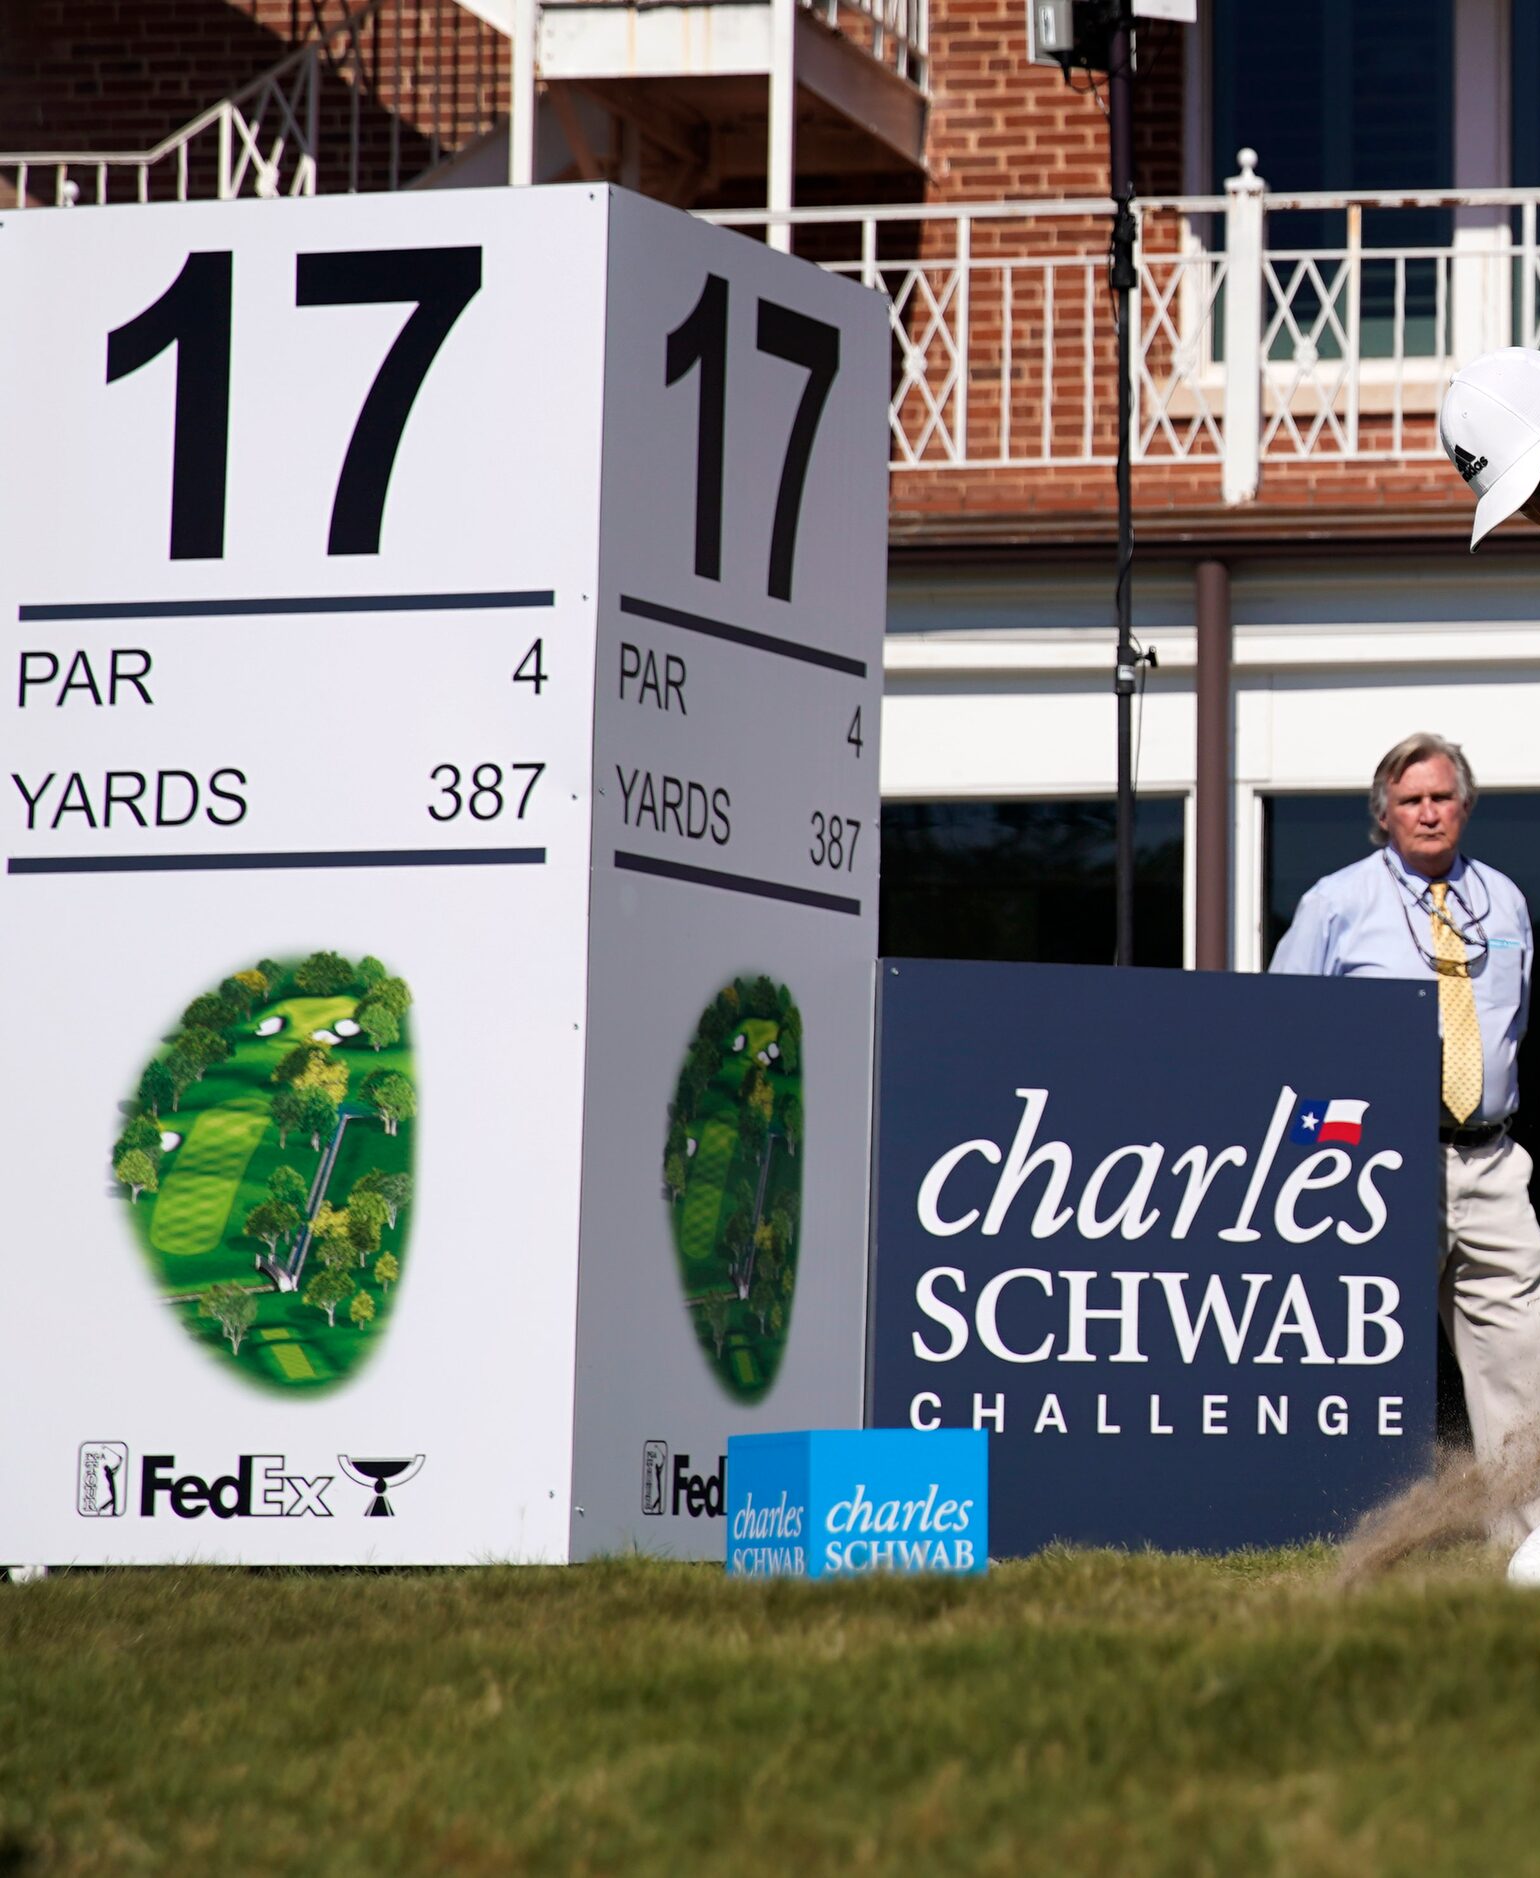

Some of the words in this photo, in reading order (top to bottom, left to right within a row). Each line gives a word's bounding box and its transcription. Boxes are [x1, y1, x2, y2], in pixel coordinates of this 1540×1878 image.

[106, 246, 482, 560] 17
[665, 272, 841, 603] 17
[18, 649, 154, 708] PAR
[512, 639, 548, 695] 4
[619, 642, 687, 716] PAR
[847, 706, 864, 759] 4
[11, 768, 248, 830] YARDS
[427, 763, 546, 822] 387
[615, 765, 731, 846] YARDS
[810, 811, 861, 872] 387
[917, 1086, 1403, 1245] charles
[912, 1266, 1404, 1365] SCHWAB
[910, 1391, 1403, 1436] CHALLENGE
[140, 1454, 335, 1520] FedEx
[671, 1454, 728, 1519] Fed
[733, 1490, 805, 1540] charles
[825, 1484, 974, 1533] charles
[733, 1546, 805, 1577] SCHWAB
[825, 1540, 975, 1571] SCHWAB
